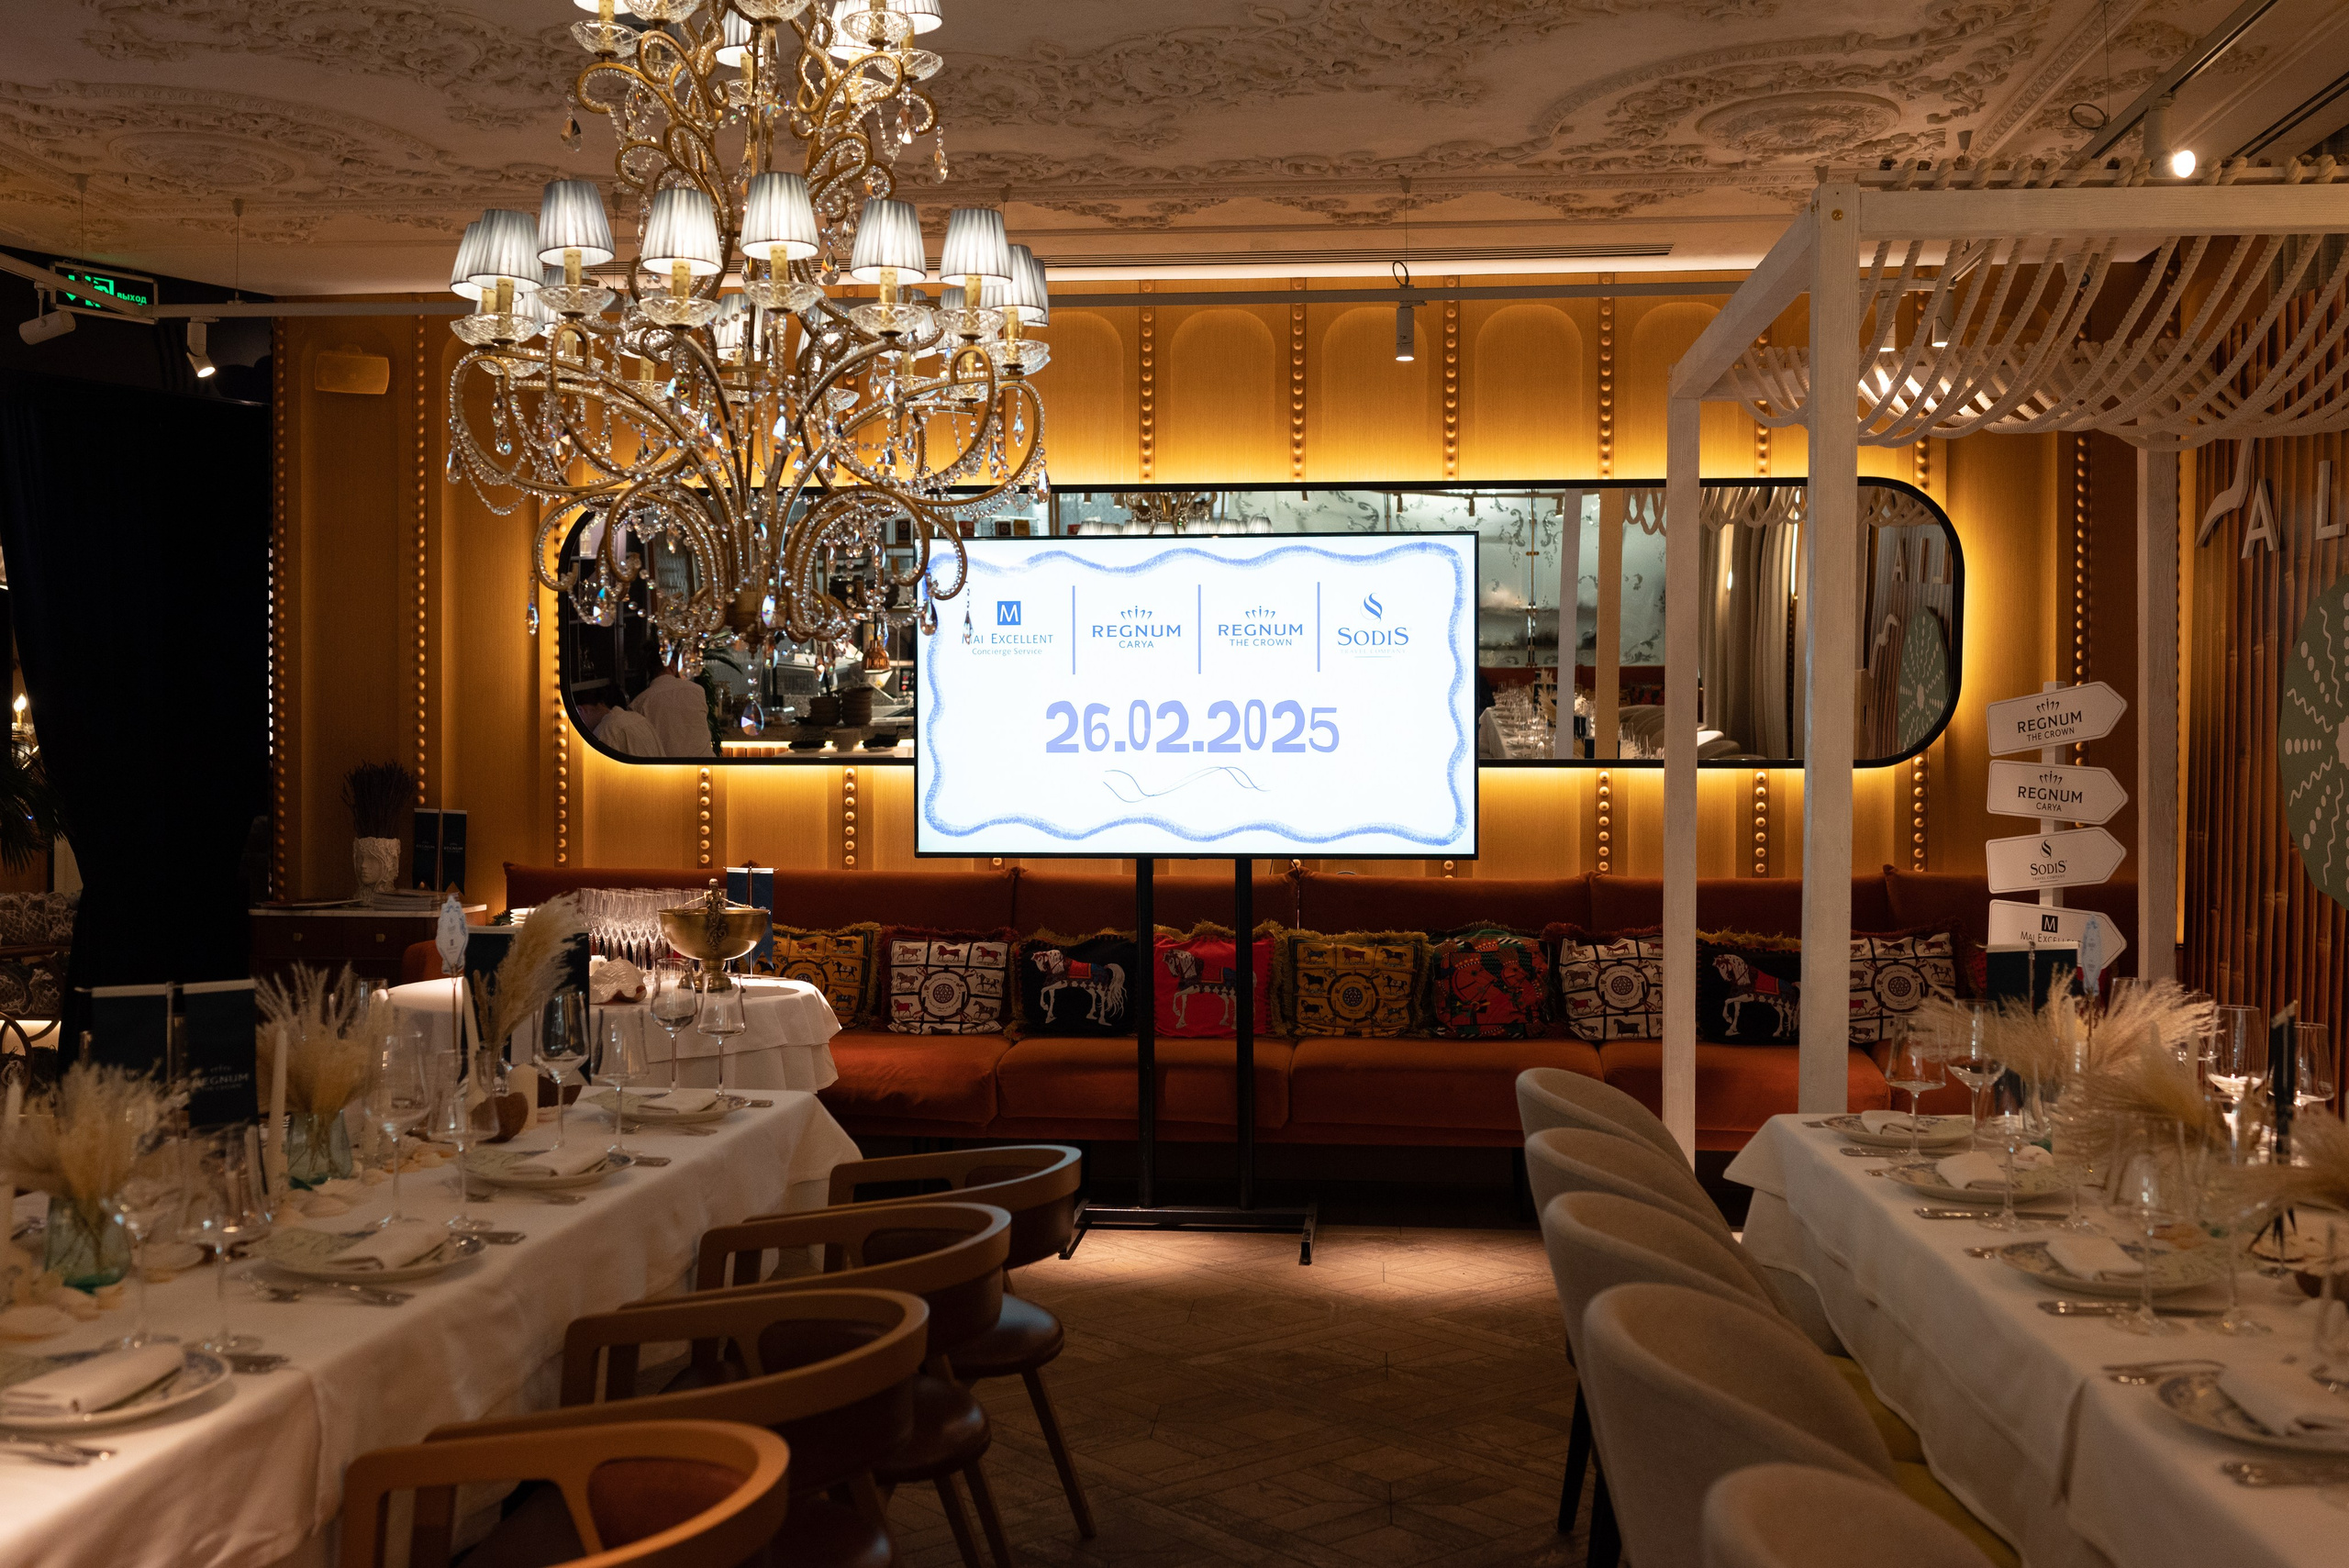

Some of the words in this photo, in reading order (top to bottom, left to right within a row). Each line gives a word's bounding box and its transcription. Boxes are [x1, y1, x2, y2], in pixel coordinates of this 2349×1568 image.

[998, 603, 1020, 624] M
[1092, 625, 1181, 638] REGNUM
[1218, 624, 1303, 636] REGNUM
[1337, 627, 1409, 646] SODIS
[991, 632, 1053, 644] EXCELLENT
[1119, 639, 1154, 649] CARYA
[1230, 639, 1249, 647] THE
[1252, 639, 1293, 647] CROWN
[972, 647, 1012, 657] Concierge
[1013, 647, 1042, 655] Service
[1046, 699, 1339, 752] 26.02.2025
[2017, 710, 2082, 733] REGNUM
[2027, 732, 2043, 741] THE
[2044, 727, 2075, 740] CROWN
[2018, 785, 2083, 804] REGNUM
[2036, 802, 2062, 812] CARYA
[2030, 860, 2066, 876] SODIS
[2043, 916, 2057, 931] M
[2021, 931, 2035, 941] MAI
